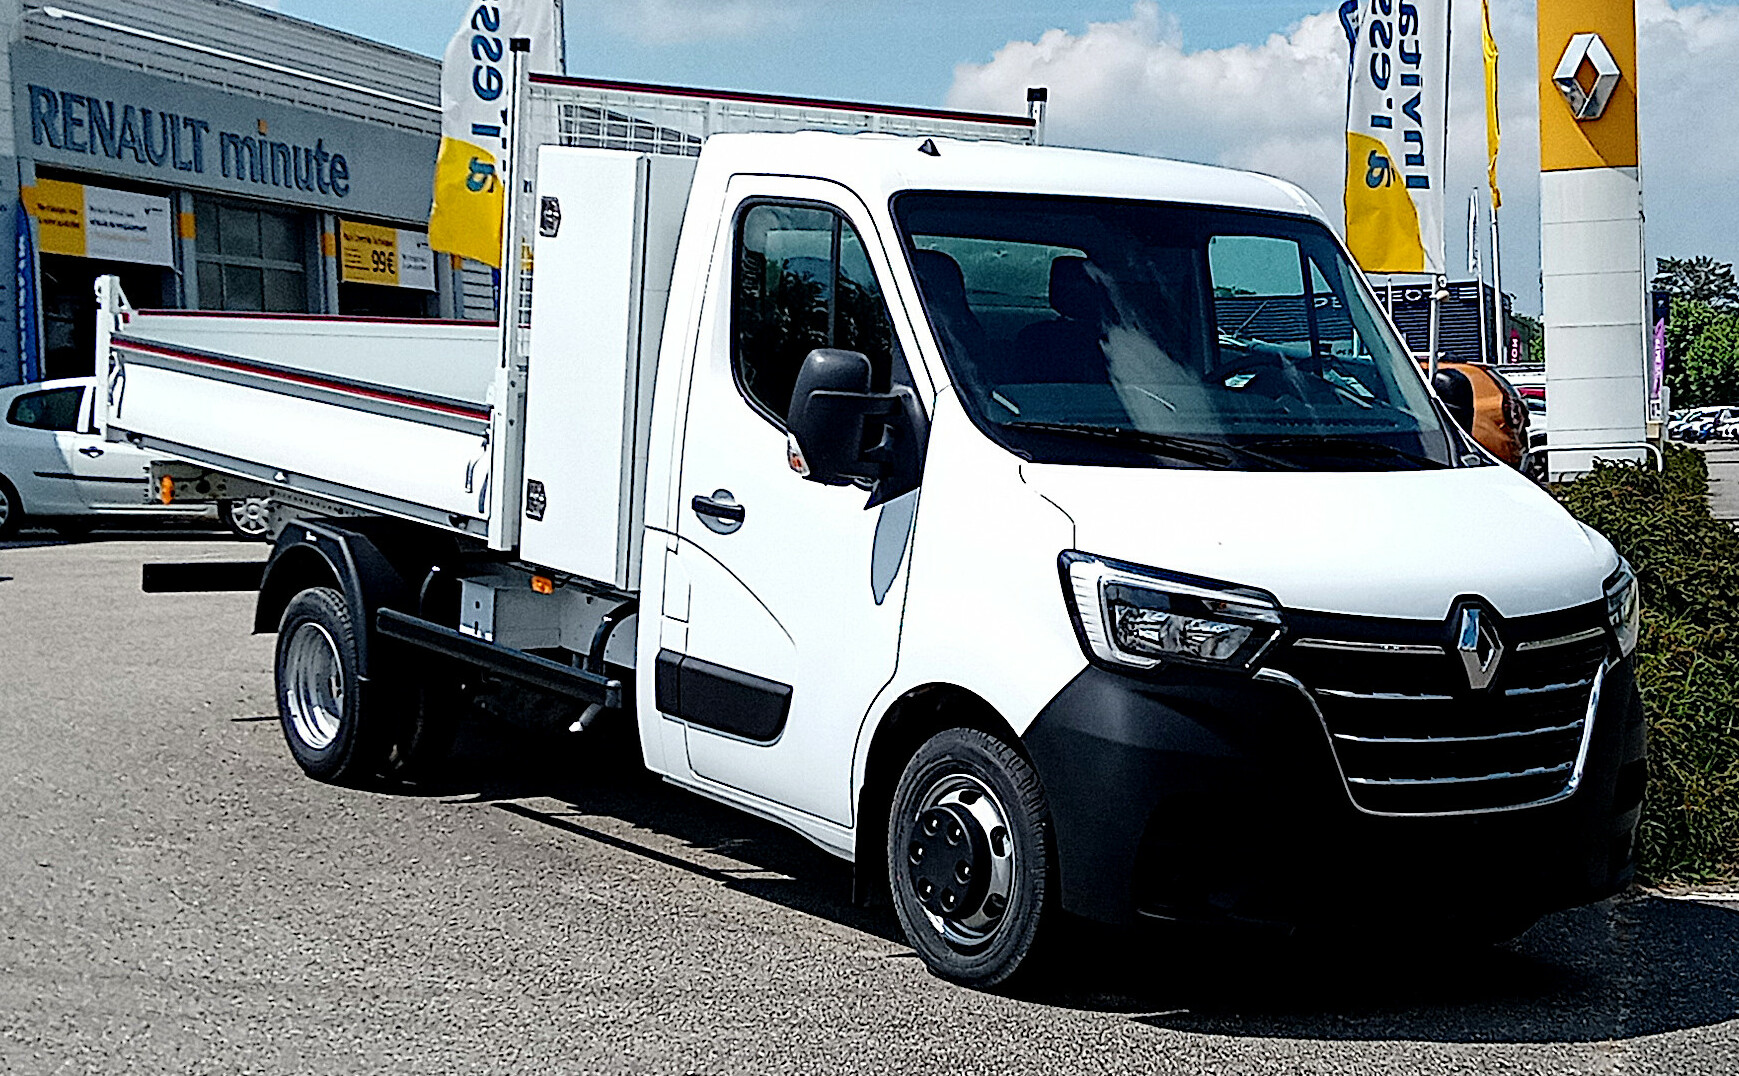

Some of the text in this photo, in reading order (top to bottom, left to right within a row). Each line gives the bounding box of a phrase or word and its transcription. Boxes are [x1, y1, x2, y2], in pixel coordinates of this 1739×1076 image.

[28, 83, 350, 198] RENAULT minute
[371, 249, 396, 275] 99€
